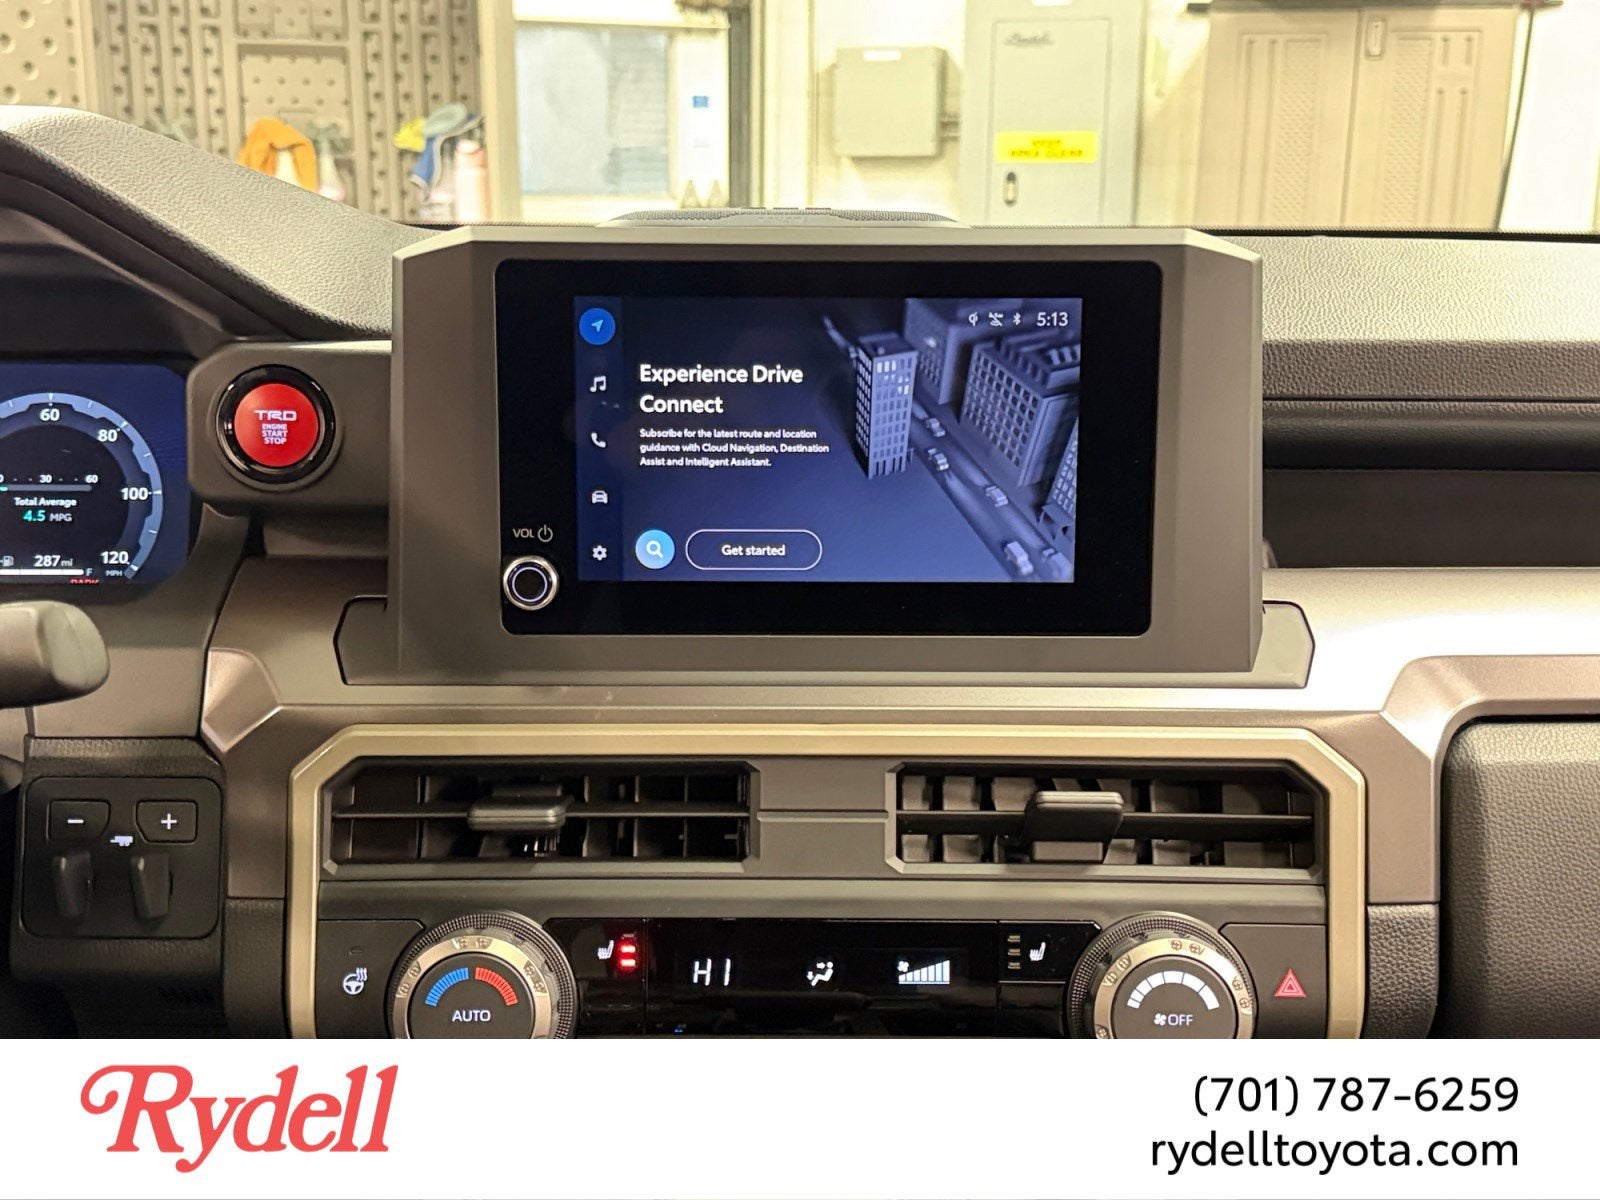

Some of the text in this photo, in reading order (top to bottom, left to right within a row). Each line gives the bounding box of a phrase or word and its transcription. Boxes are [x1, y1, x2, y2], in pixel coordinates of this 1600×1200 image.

[1036, 311, 1069, 328] 5:13
[639, 363, 804, 387] Experience Drive
[639, 394, 724, 414] Connect
[40, 408, 60, 422] 60
[254, 409, 297, 422] TRD
[97, 429, 118, 443] 80
[262, 430, 288, 438] START
[639, 428, 817, 439] Subscribe for the latest route and location
[264, 437, 287, 445] STOP
[639, 442, 830, 455] guidance with Cloud Navigation, Destination
[639, 456, 772, 469] Assist and Intelligent Assistant.
[39, 474, 53, 484] 30
[85, 474, 99, 484] 60
[121, 487, 148, 501] 100
[14, 496, 77, 508] Total Average
[23, 509, 73, 522] 4.5 MPG
[512, 528, 535, 538] VOL
[721, 543, 786, 557] Get started
[33, 554, 74, 567] 287 mi
[101, 550, 128, 565] 120
[86, 567, 93, 577] F
[105, 569, 123, 577] MPH
[692, 957, 731, 987] HI
[451, 1009, 491, 1022] AUTO
[1167, 1013, 1194, 1027] OFF
